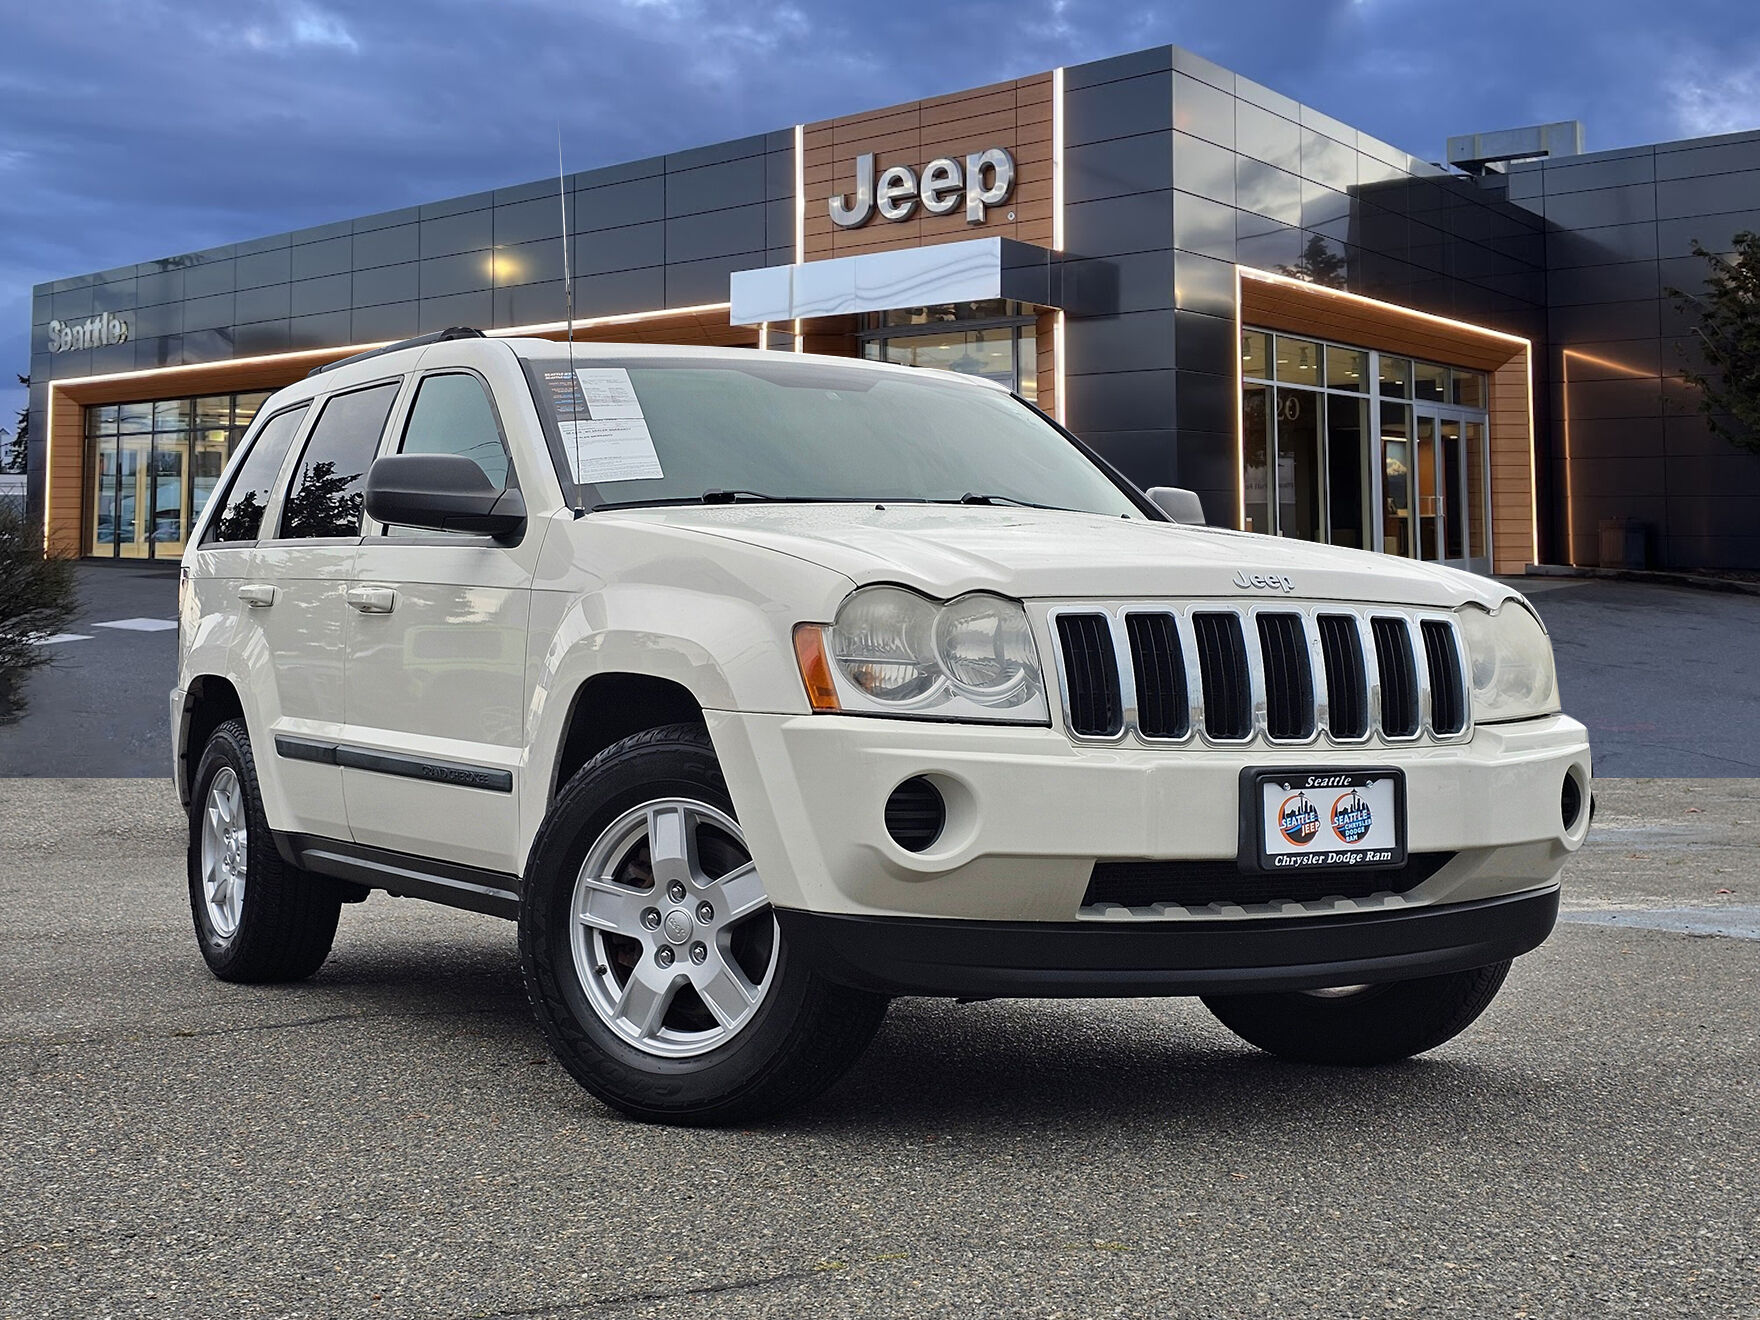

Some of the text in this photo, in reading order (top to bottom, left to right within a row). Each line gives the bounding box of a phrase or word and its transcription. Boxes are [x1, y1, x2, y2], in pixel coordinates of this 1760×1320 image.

[828, 146, 1016, 229] Jeep
[48, 311, 128, 353] Seattle
[1232, 569, 1296, 593] Jeep
[1305, 775, 1352, 787] Seattle
[1280, 812, 1316, 829] SEATTLE
[1332, 810, 1368, 827] SEATTLE
[1344, 818, 1372, 830] CHRYSLER
[1301, 821, 1321, 837] JEEP
[1345, 827, 1365, 836] DODGE
[1346, 834, 1358, 842] RAM
[1274, 851, 1392, 867] Chrysler Dodge Ram
